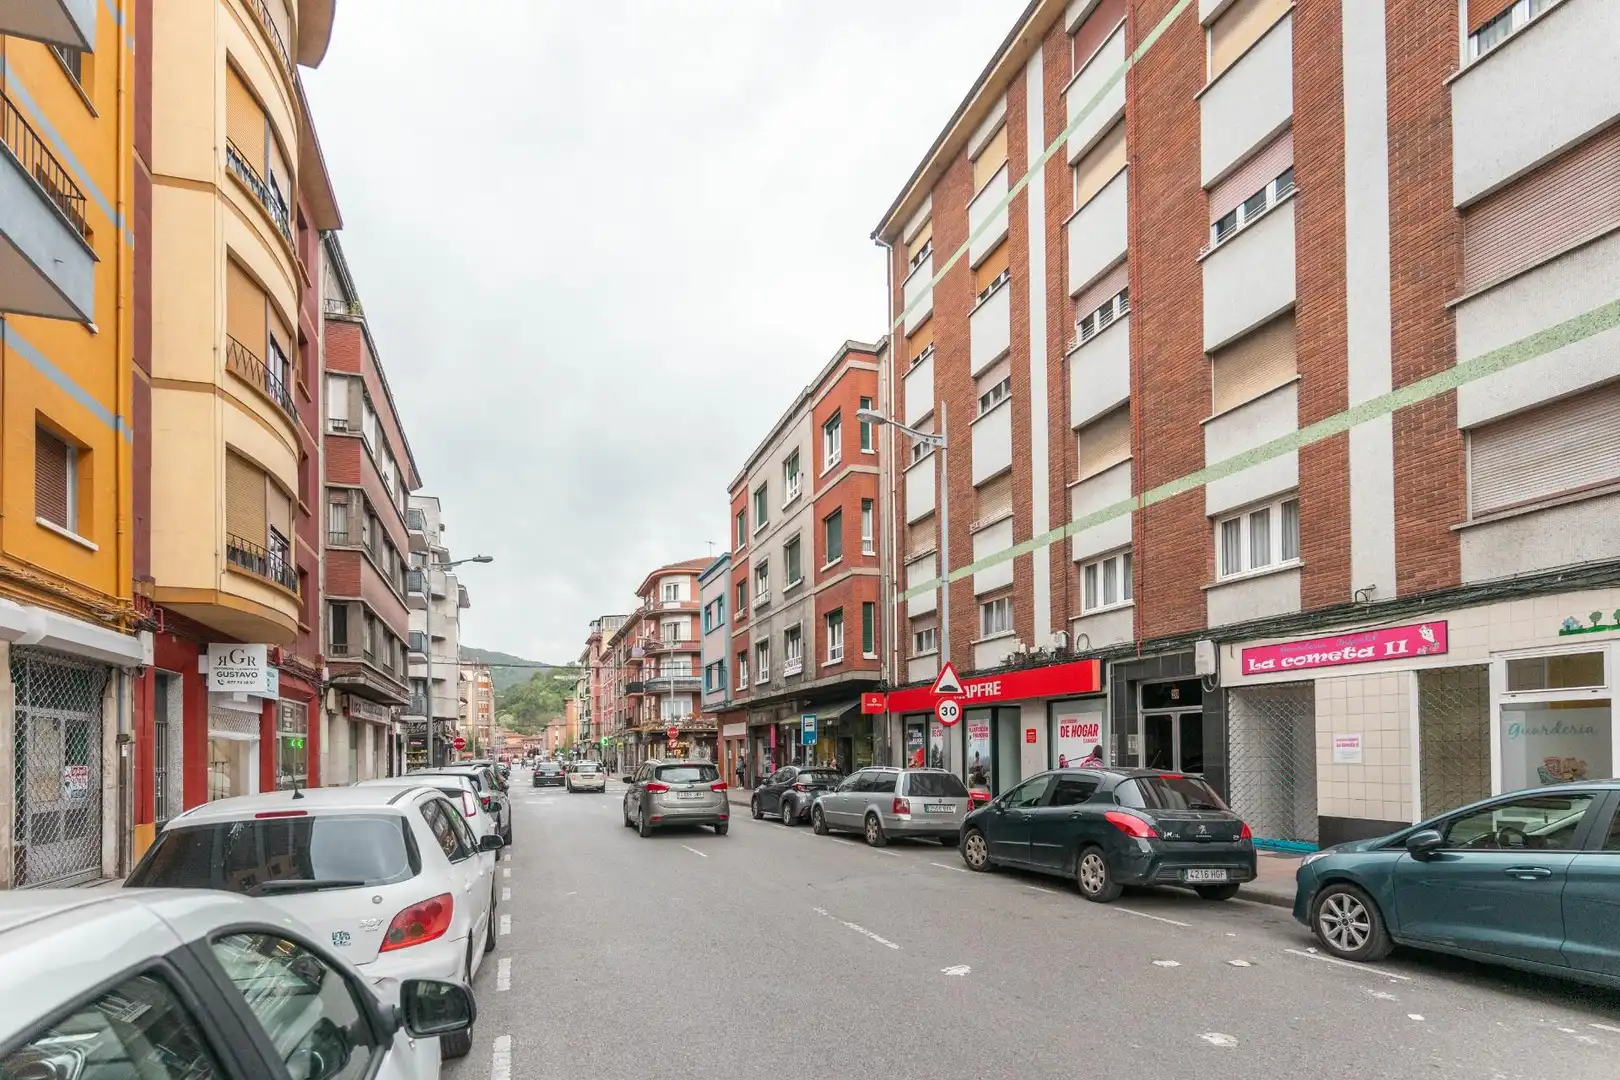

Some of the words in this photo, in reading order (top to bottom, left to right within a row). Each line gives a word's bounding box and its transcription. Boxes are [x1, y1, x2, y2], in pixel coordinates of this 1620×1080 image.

[1249, 658, 1275, 671] La
[1281, 645, 1375, 667] cometa
[1384, 639, 1409, 656] II
[216, 671, 258, 679] GUSTAVO
[941, 706, 957, 716] 30
[1060, 725, 1070, 738] DE
[1071, 723, 1099, 738] HOGAR
[359, 917, 385, 929] 307
